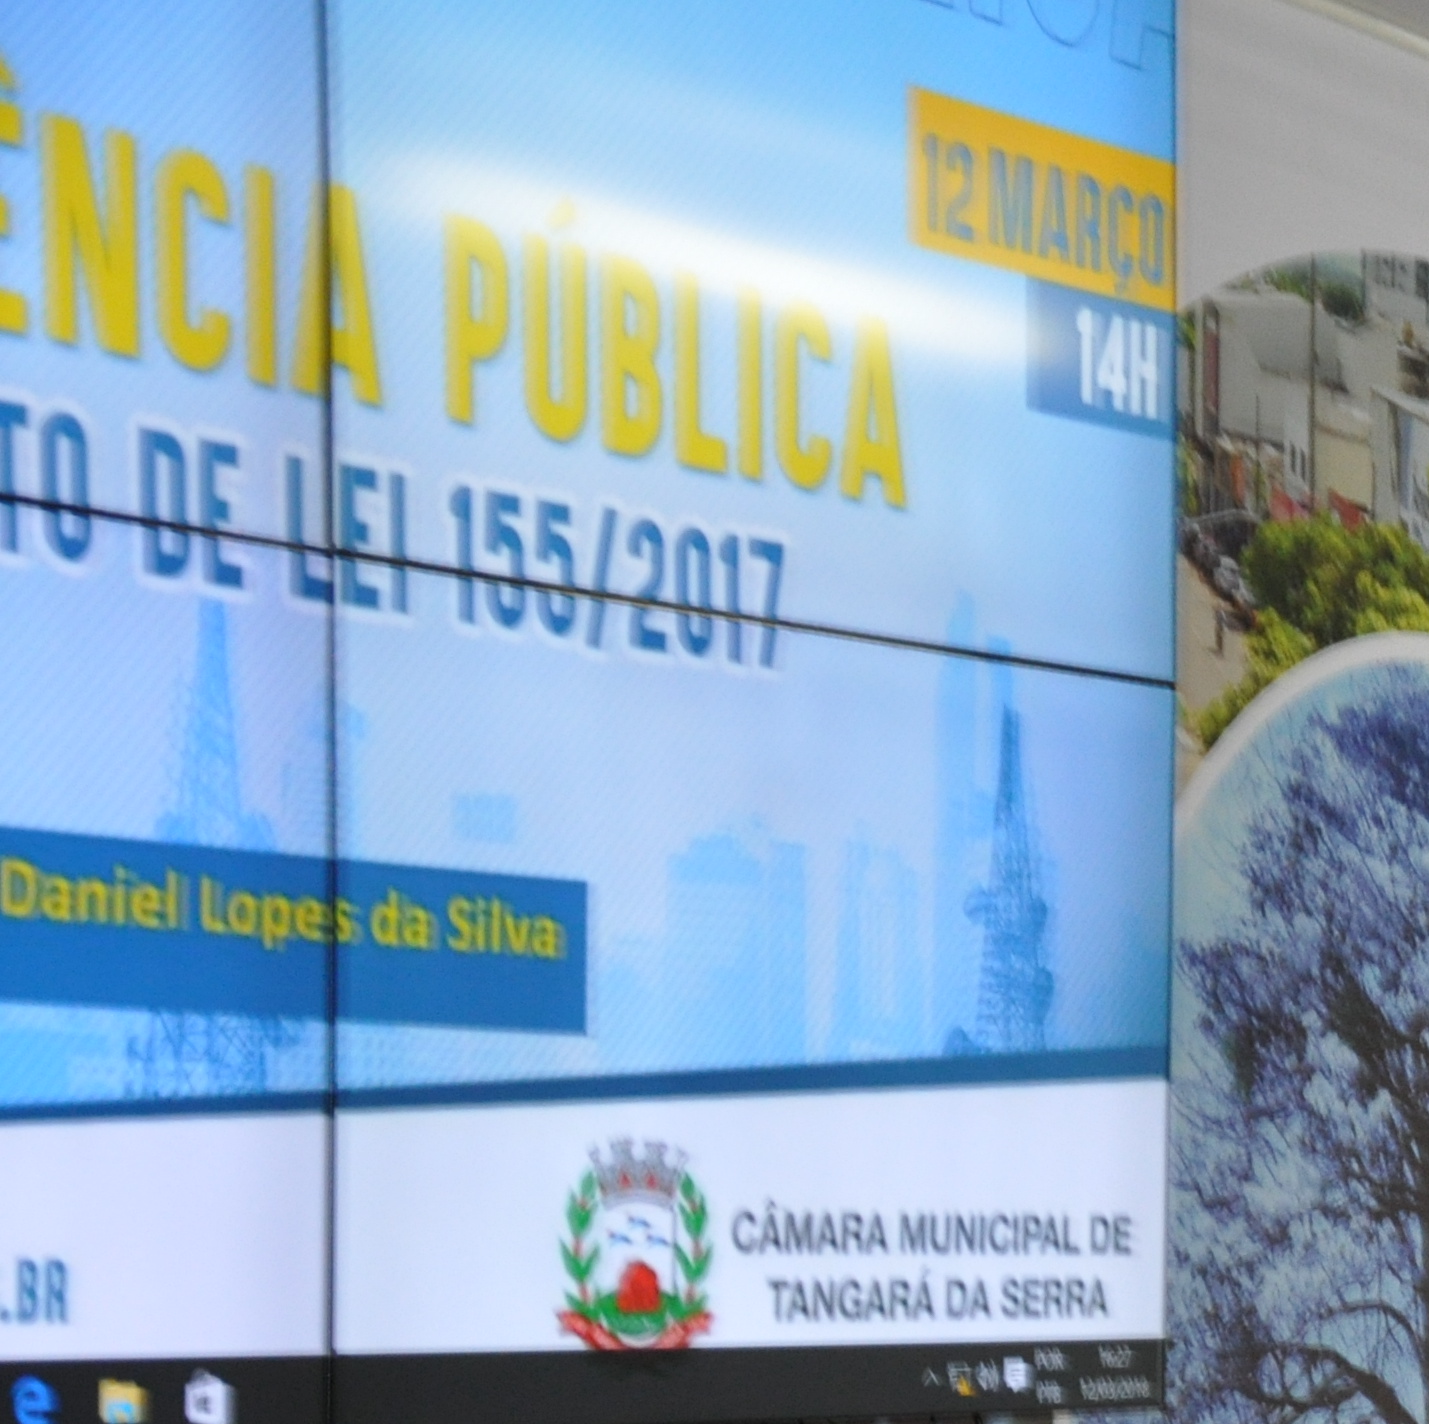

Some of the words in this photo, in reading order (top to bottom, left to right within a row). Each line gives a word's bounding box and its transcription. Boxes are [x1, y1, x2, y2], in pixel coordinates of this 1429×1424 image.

[923, 132, 975, 243] 12
[988, 146, 1165, 294] MARÇO
[442, 199, 907, 509] PÚBLICA
[1077, 306, 1158, 420] 14H
[138, 428, 243, 590] DE
[285, 456, 408, 614] LEI
[448, 486, 785, 668] 155/2017
[1, 856, 186, 931] Daniel
[201, 875, 358, 951] Lopes
[370, 887, 436, 950] da
[448, 896, 565, 959] Silva
[731, 1198, 889, 1256] CÂMARA
[899, 1209, 1080, 1257] MUNICIPAL
[1089, 1213, 1132, 1256] DE
[767, 1266, 934, 1322] TANGARÁ
[945, 1276, 991, 1321] DA
[1001, 1276, 1109, 1321] SERRA
